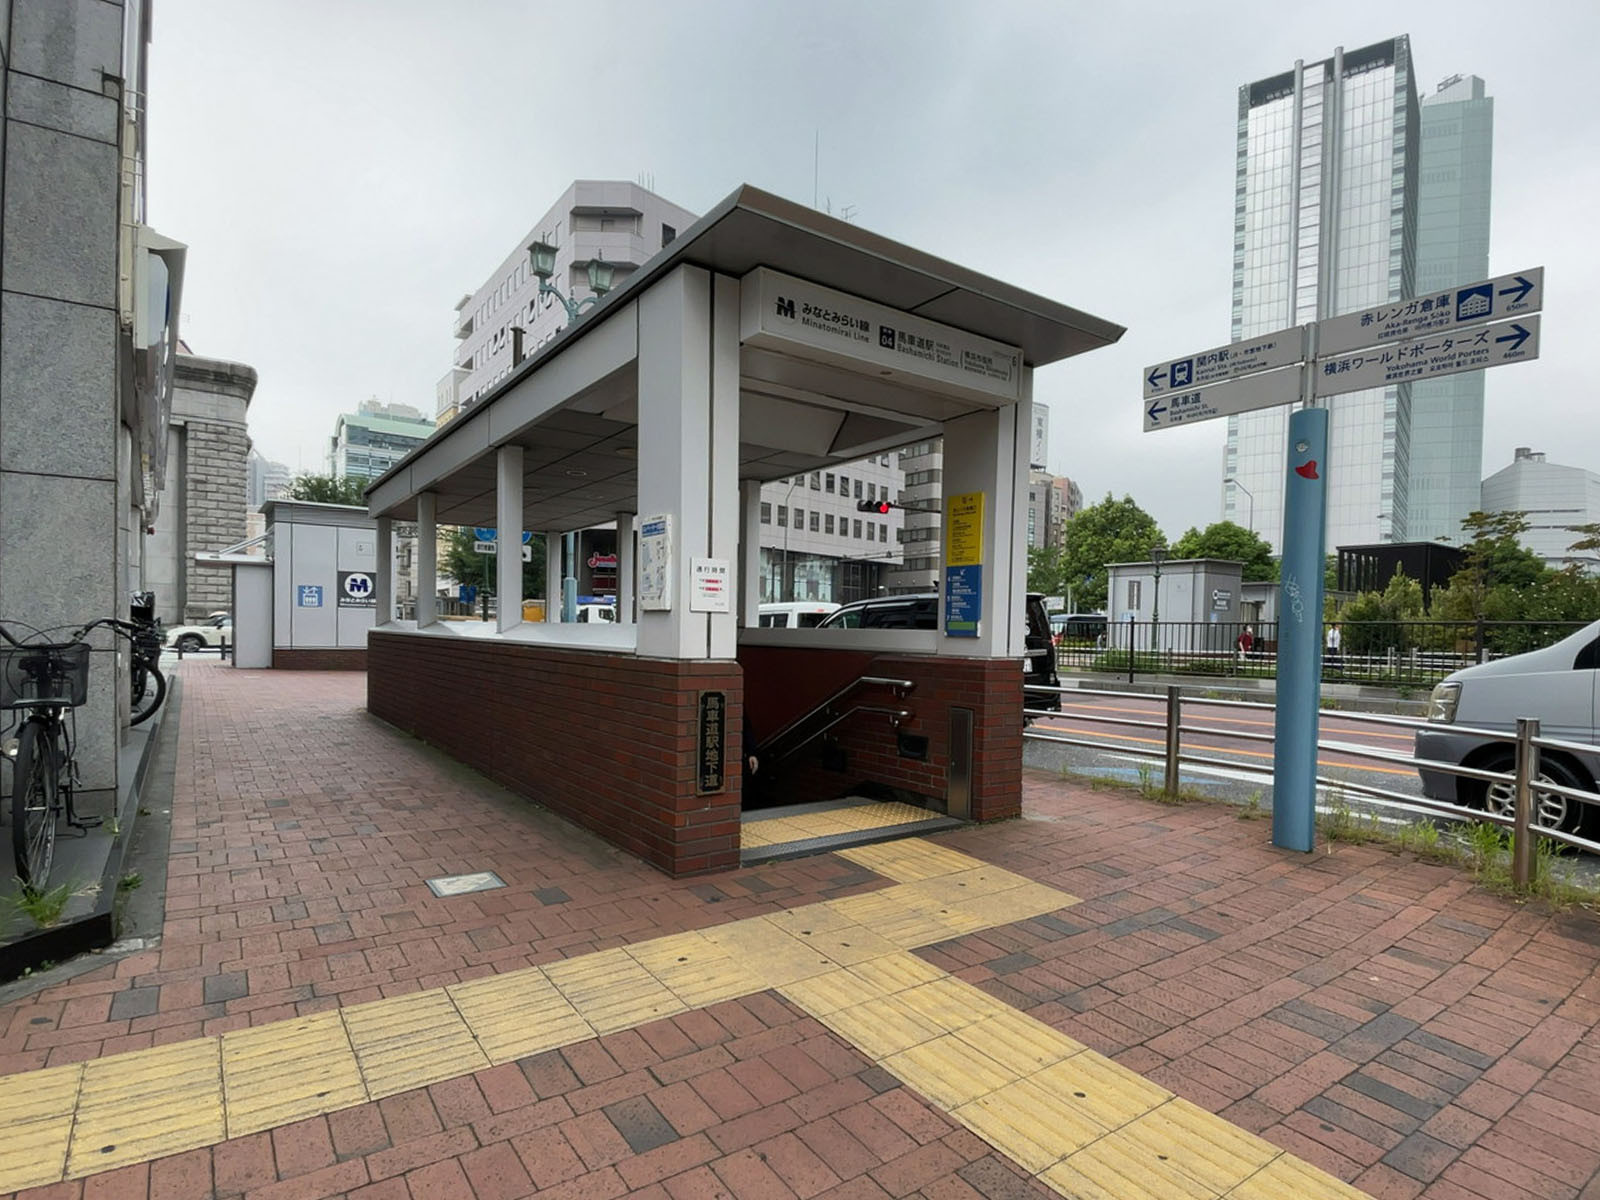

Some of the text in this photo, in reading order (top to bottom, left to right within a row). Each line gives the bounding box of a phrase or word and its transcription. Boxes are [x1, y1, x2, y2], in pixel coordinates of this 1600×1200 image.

[801, 303, 870, 333] みなとみらい線
[1361, 294, 1451, 328] 赤レンガ倉庫
[1506, 303, 1529, 312] 650m
[801, 316, 870, 344] Minatomirai Line
[881, 335, 893, 347] 04
[898, 331, 935, 353] 馬車道駅
[1324, 330, 1491, 377] 横浜ワールドポーターズ
[1196, 349, 1230, 367] 関内駅
[1386, 348, 1490, 372] Yokohama World Porters
[1503, 350, 1526, 360] 460m
[1171, 392, 1202, 408] 馬車道
[705, 696, 720, 788] 馬車道駅地下道
